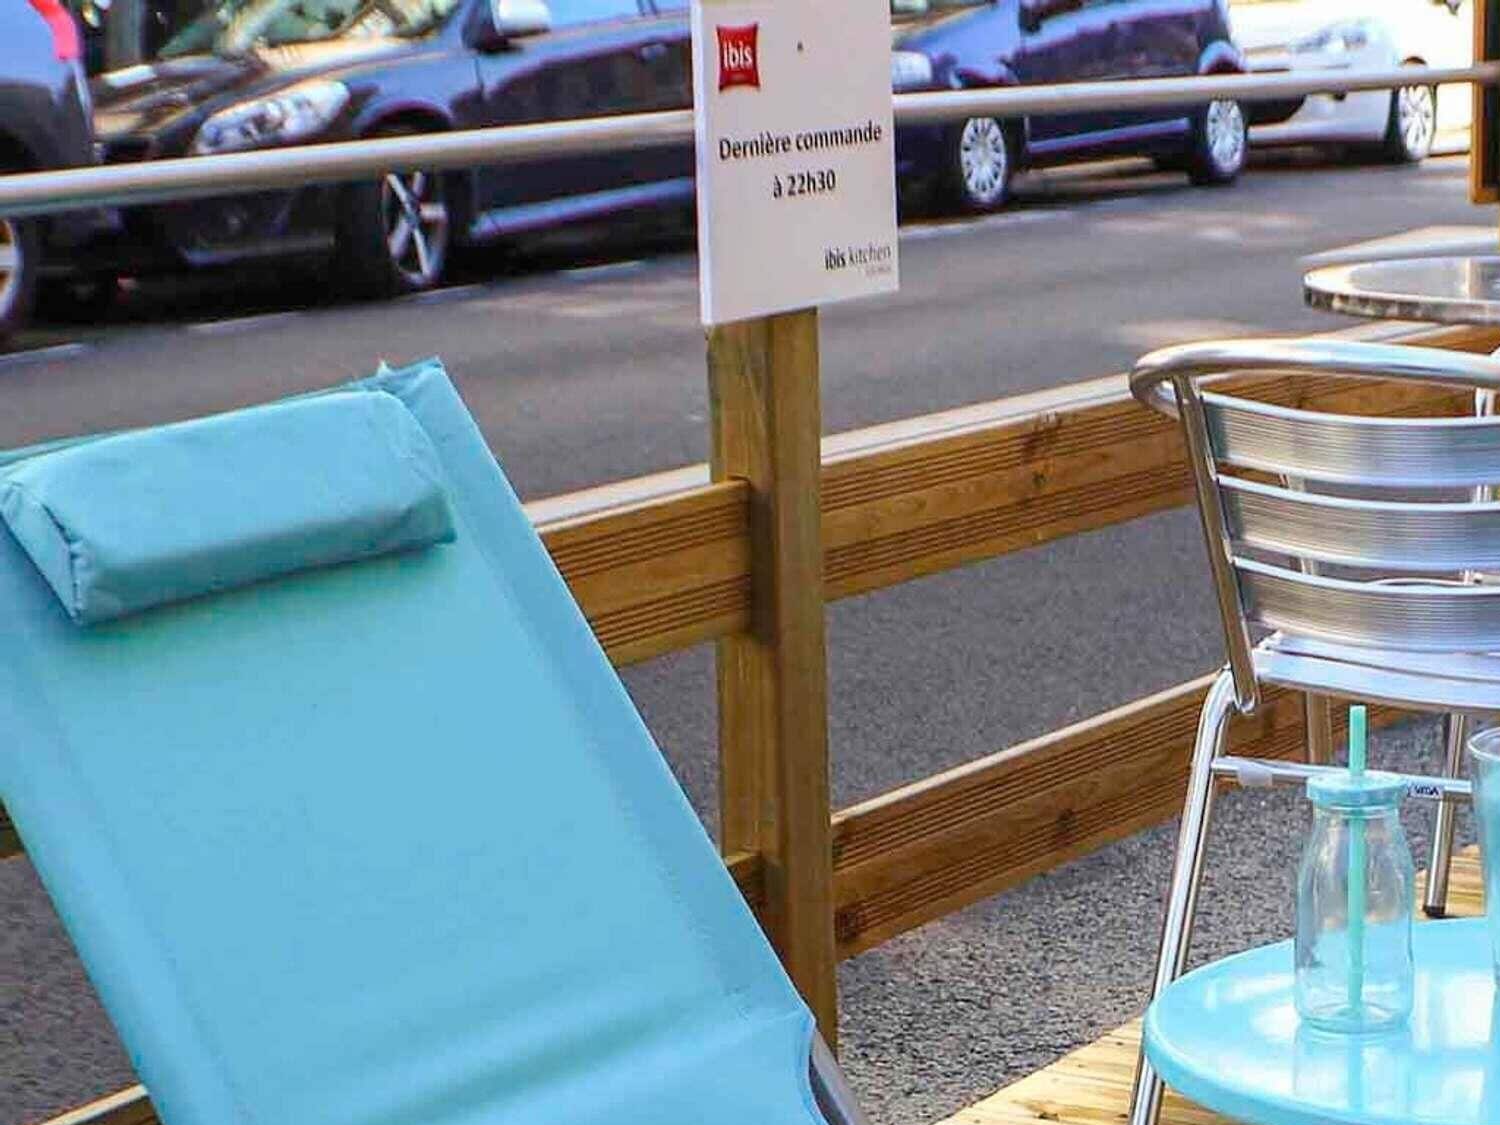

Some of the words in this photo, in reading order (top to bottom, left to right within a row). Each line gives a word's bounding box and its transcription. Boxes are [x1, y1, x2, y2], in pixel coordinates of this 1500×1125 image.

[723, 40, 752, 69] ibis
[719, 130, 791, 160] Dernière
[796, 120, 883, 150] commande
[773, 174, 783, 199] à
[787, 168, 836, 197] 22h30
[825, 246, 846, 270] ibis
[847, 243, 891, 265] kitchen
